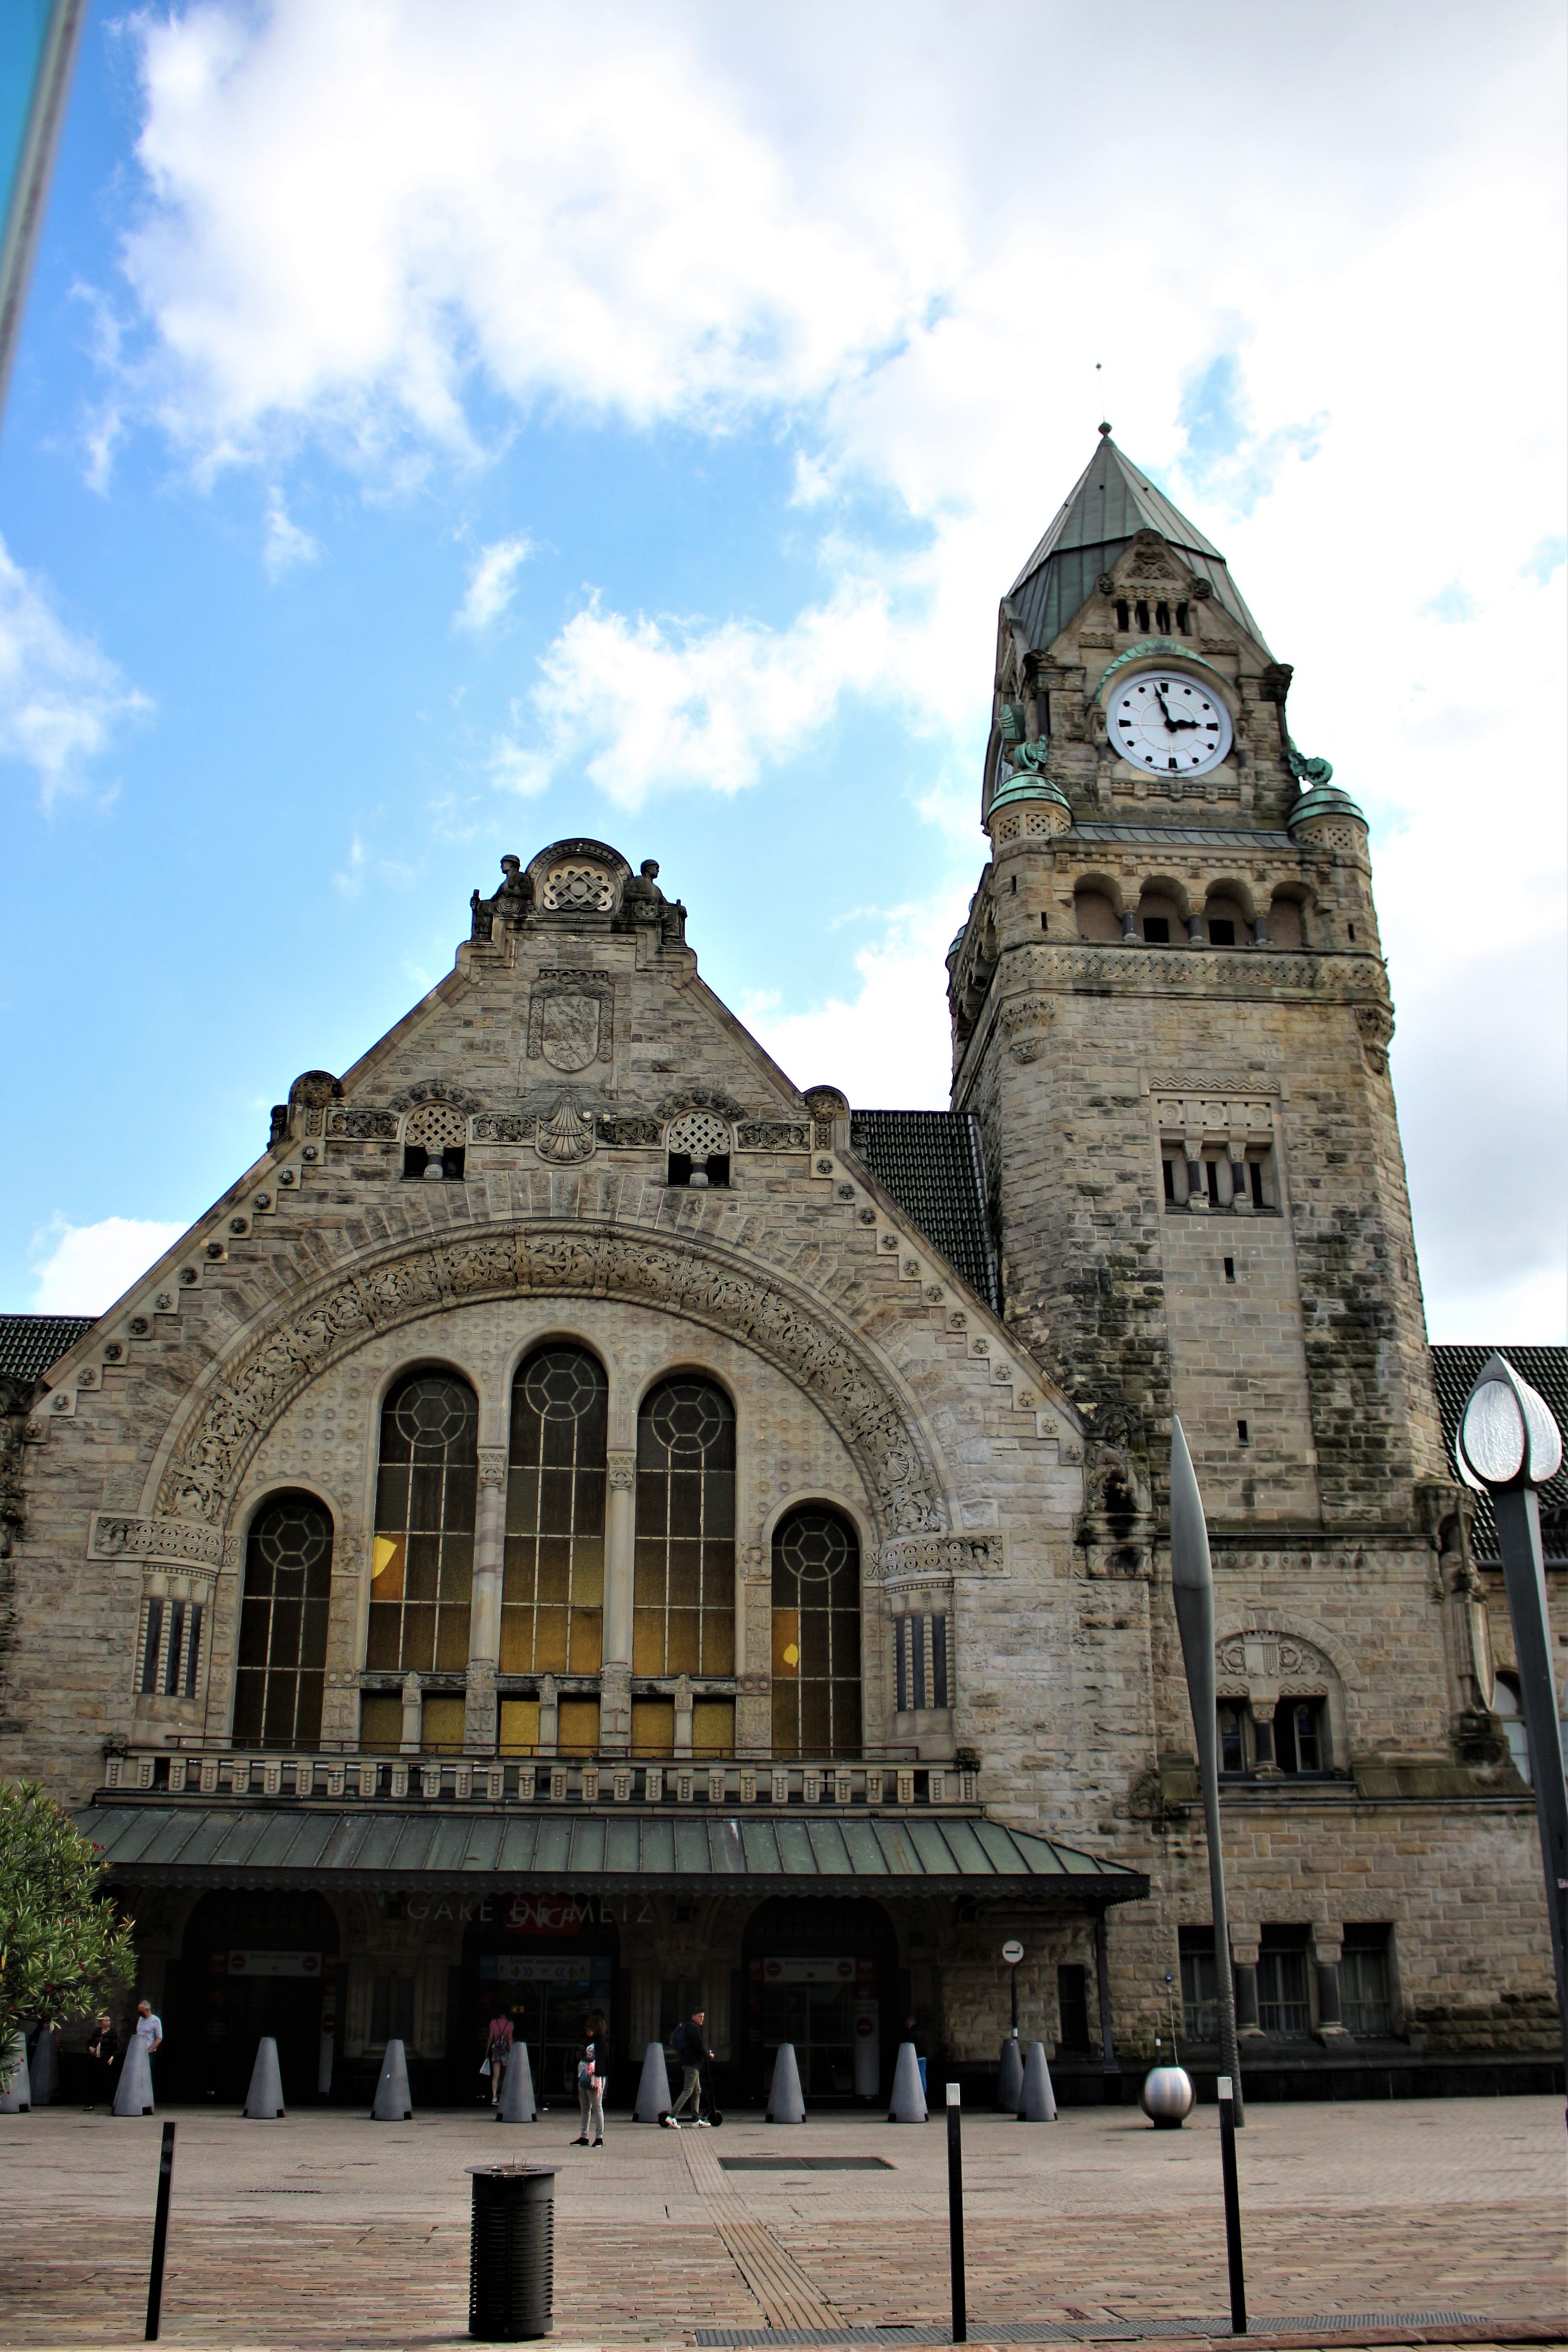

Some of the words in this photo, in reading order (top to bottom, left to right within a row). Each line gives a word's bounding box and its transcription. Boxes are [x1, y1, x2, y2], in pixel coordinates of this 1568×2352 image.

[406, 1898, 493, 1921] GARE
[512, 1897, 549, 1922] DE
[567, 1899, 653, 1922] METZ
[506, 1907, 582, 1928] SNCF
[509, 1957, 533, 1965] Entrée
[535, 1958, 579, 1967] uniquement
